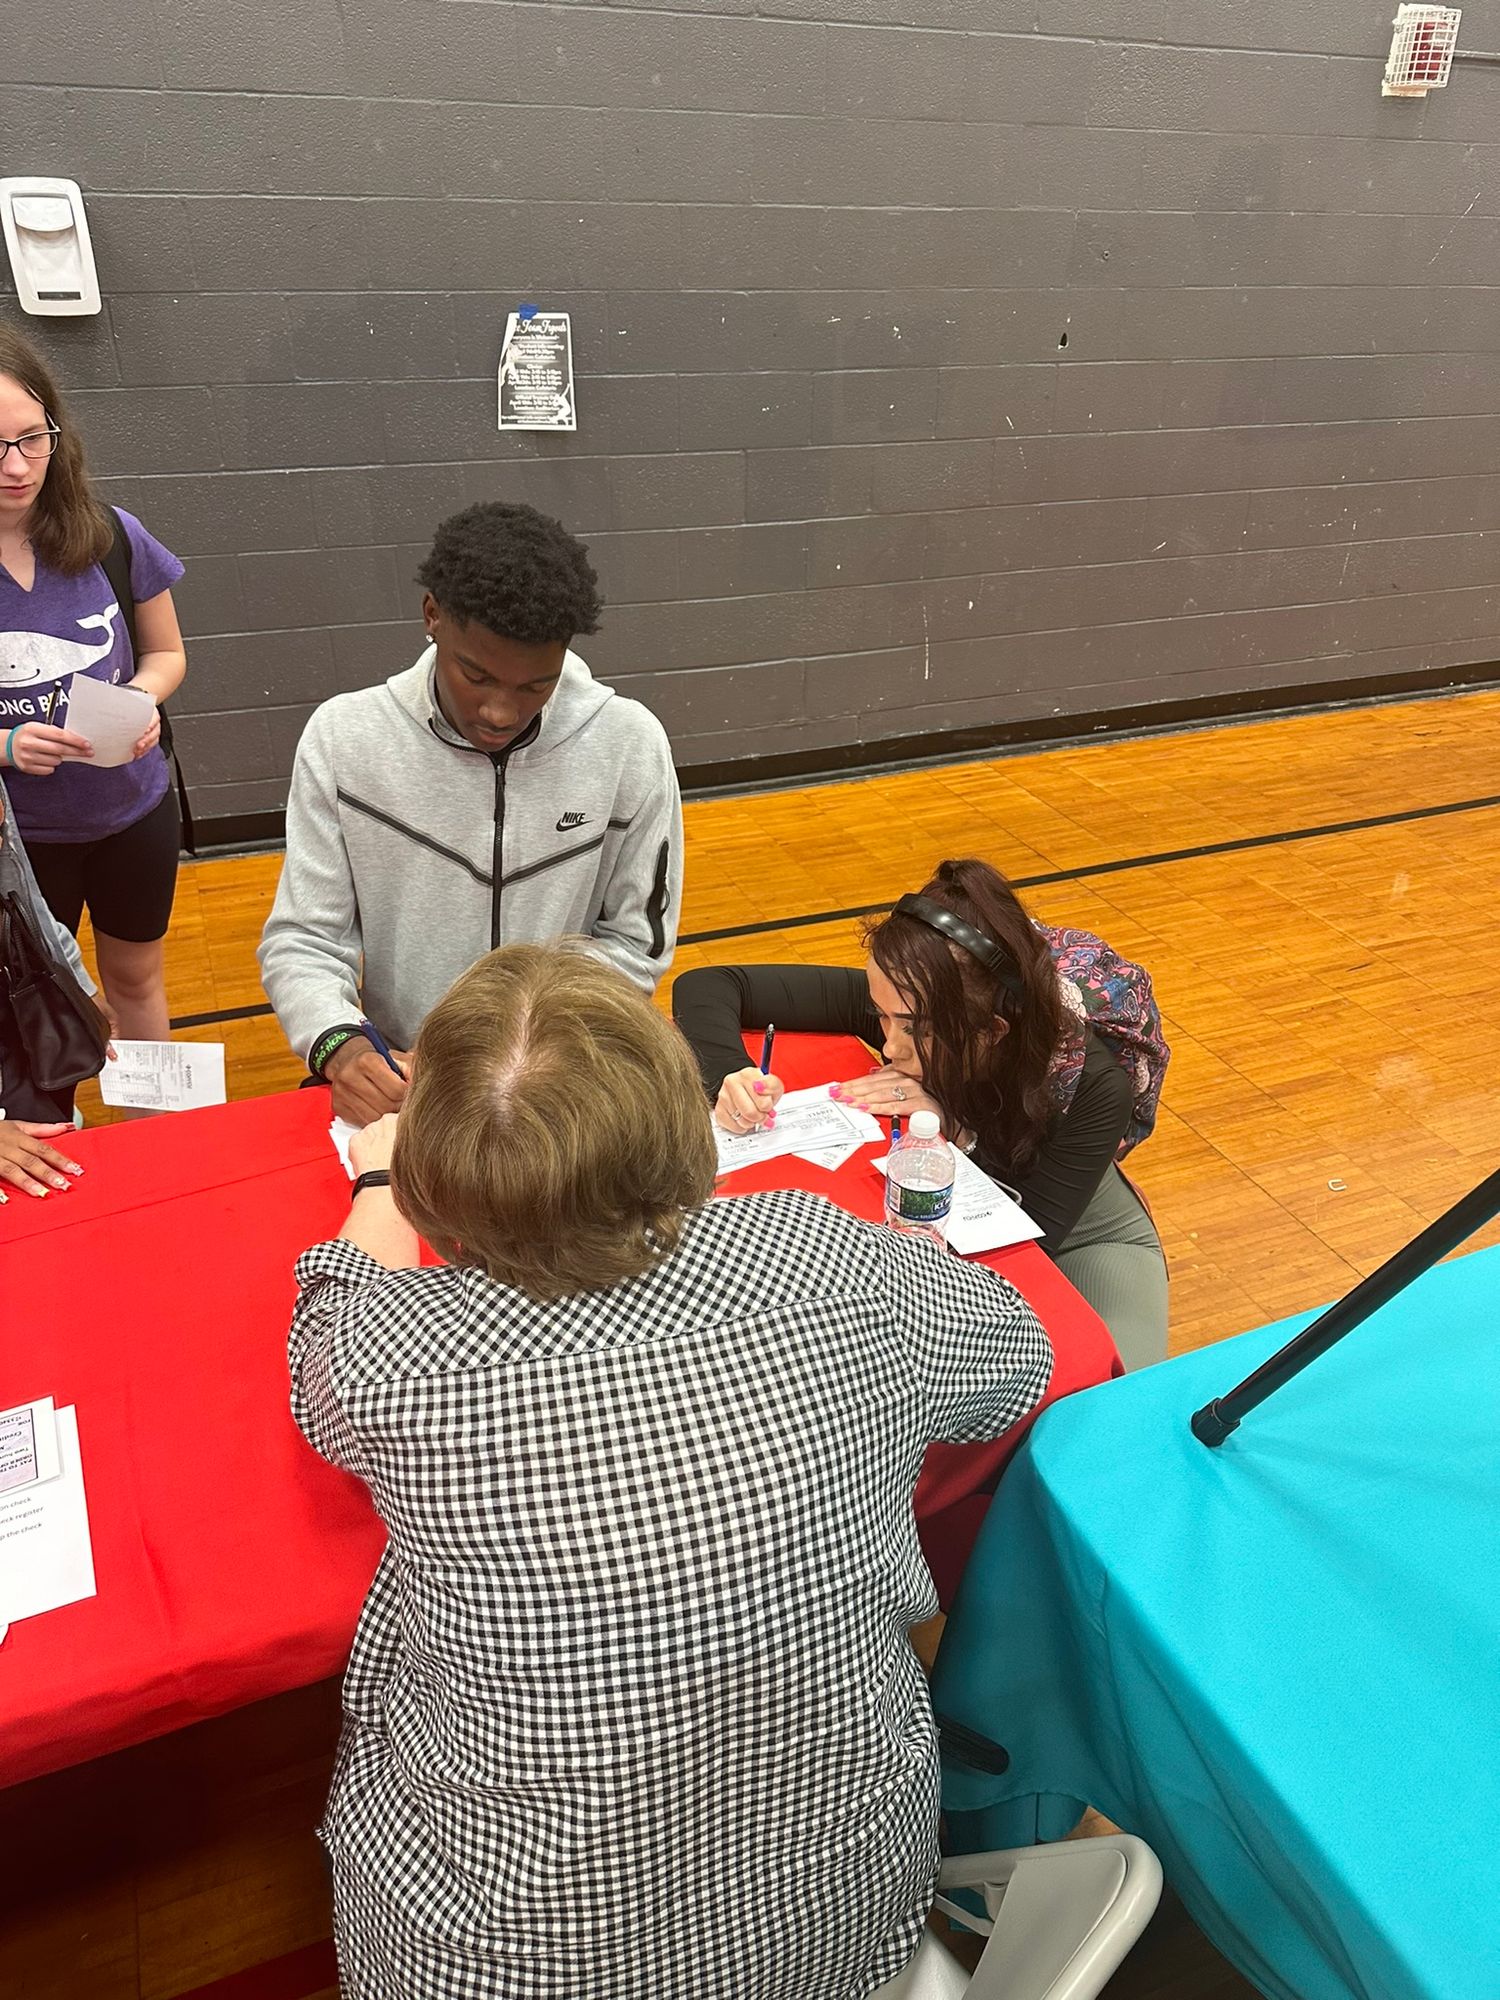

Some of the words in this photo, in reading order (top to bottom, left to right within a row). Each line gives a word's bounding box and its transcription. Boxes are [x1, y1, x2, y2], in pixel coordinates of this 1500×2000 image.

[561, 812, 586, 823] NIKE
[10, 1496, 31, 1508] check
[15, 1506, 44, 1519] register
[21, 1523, 42, 1534] check
